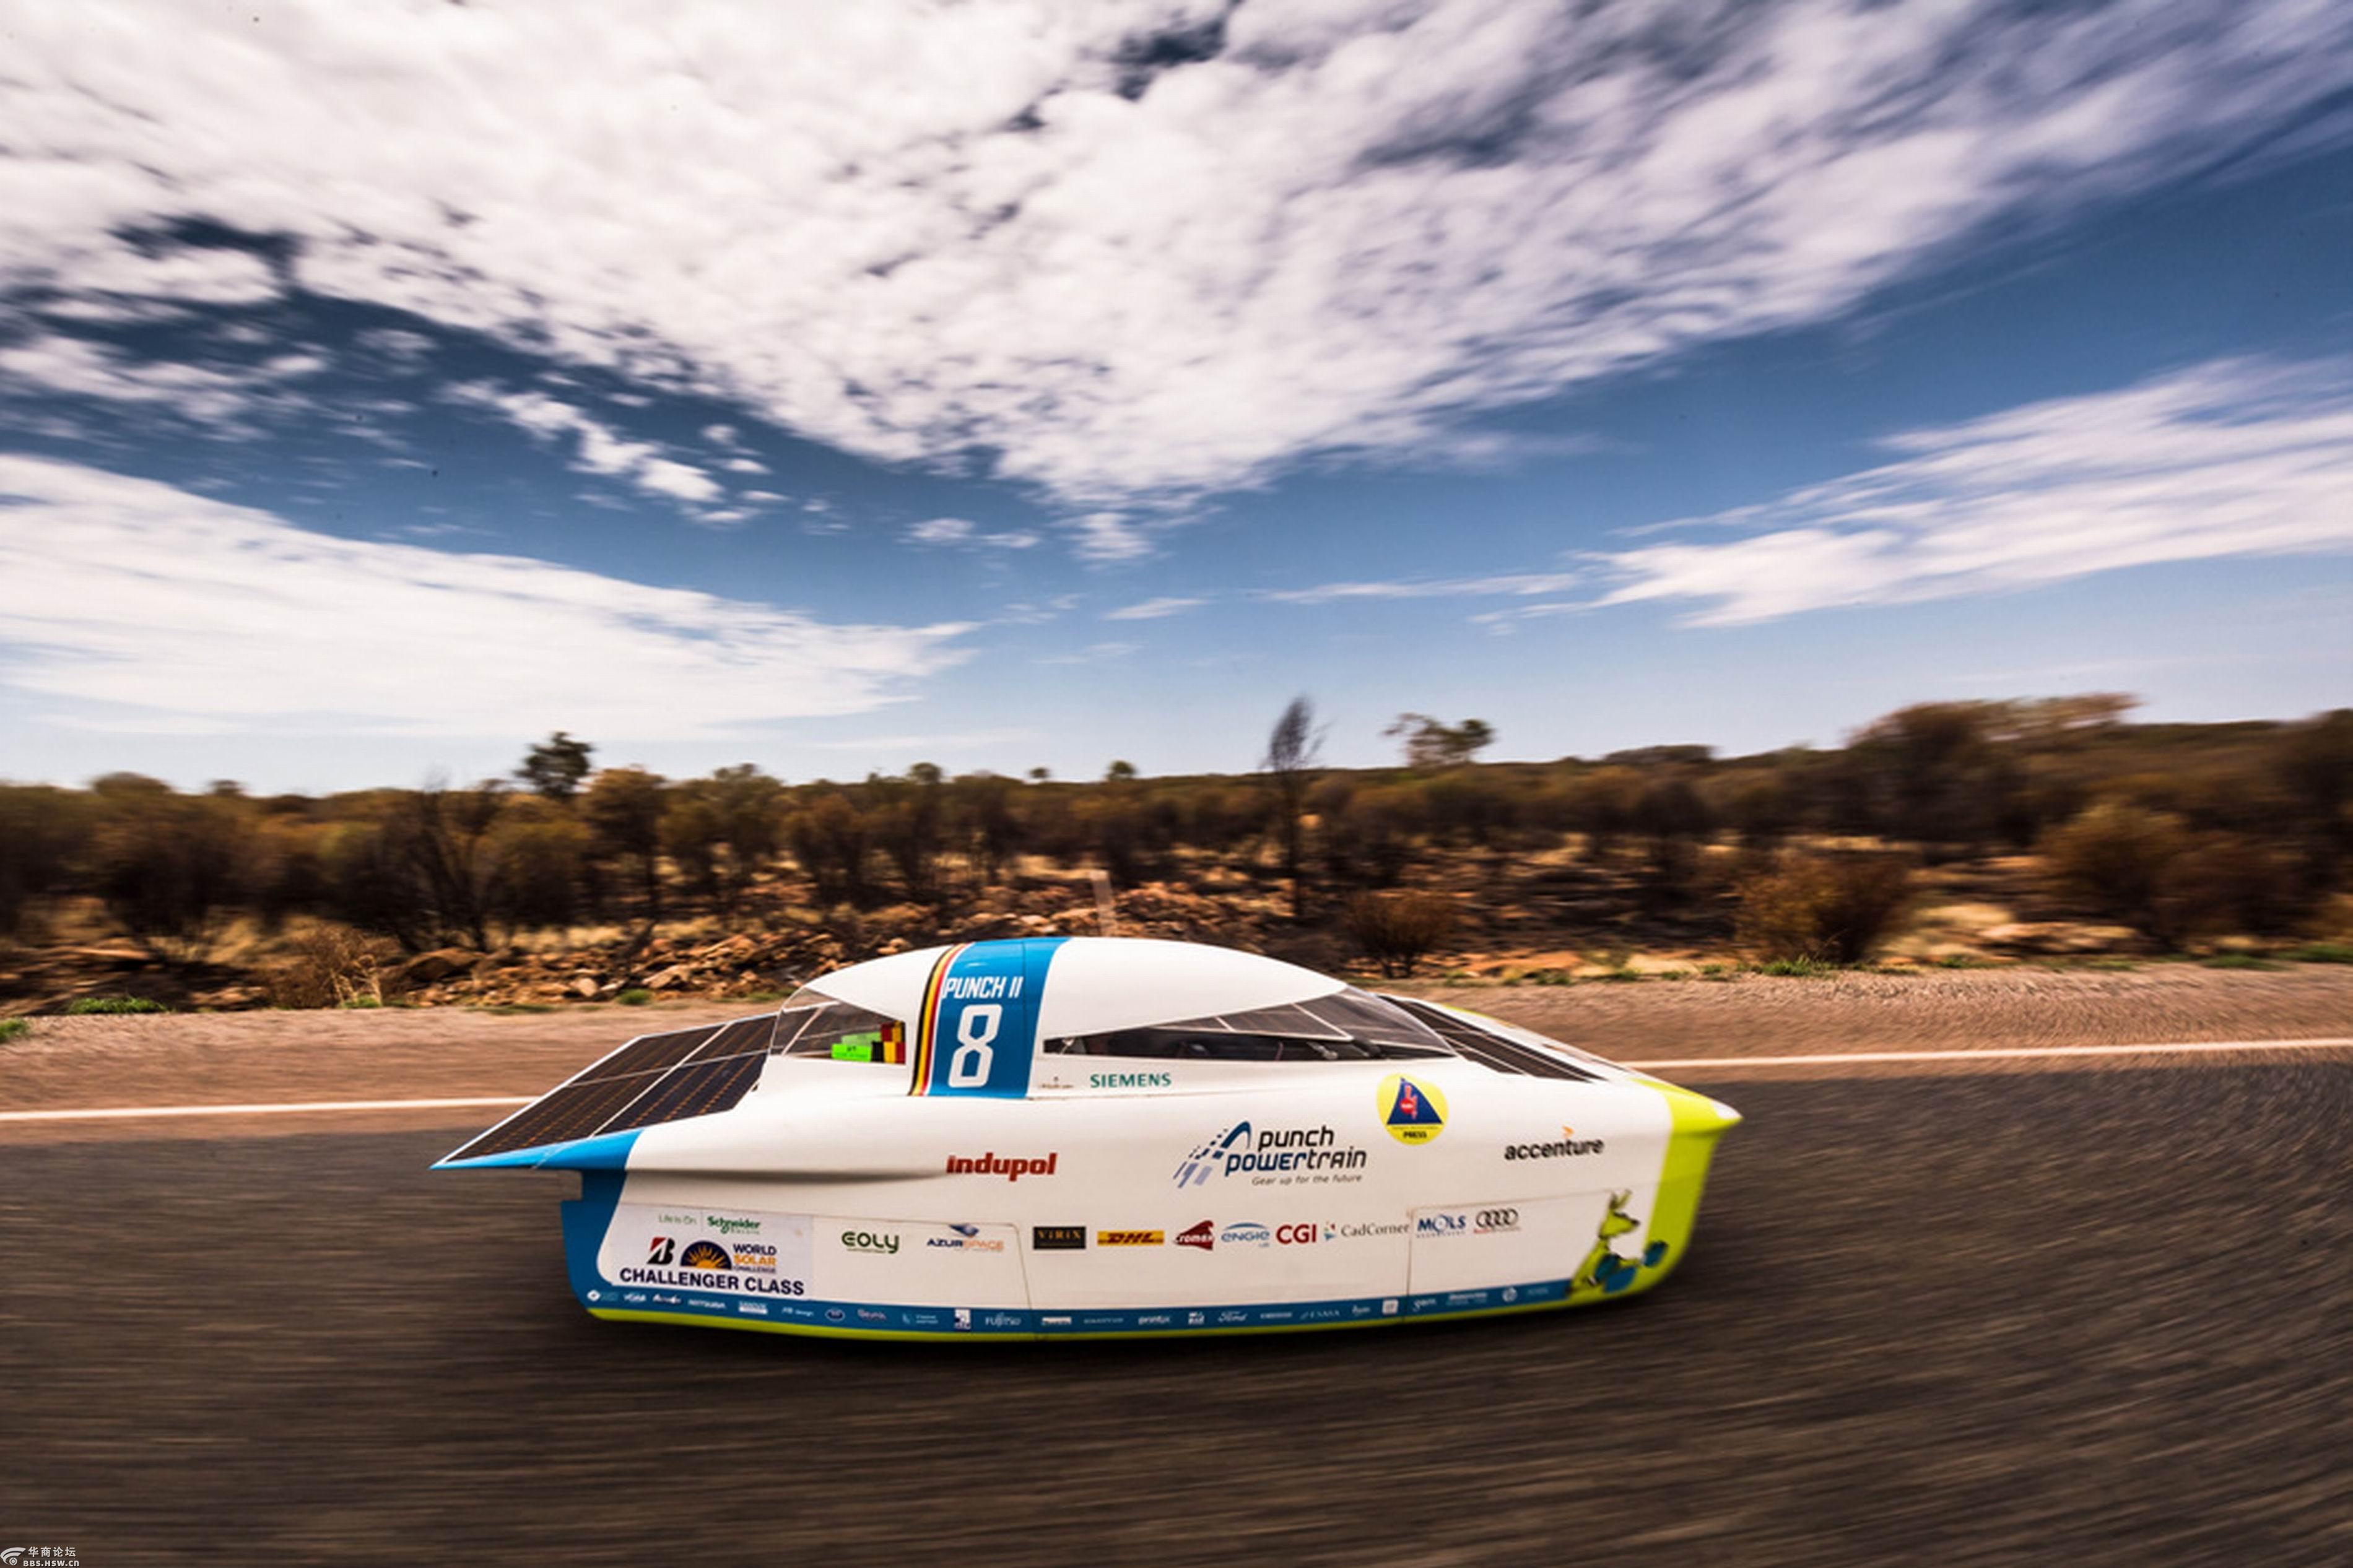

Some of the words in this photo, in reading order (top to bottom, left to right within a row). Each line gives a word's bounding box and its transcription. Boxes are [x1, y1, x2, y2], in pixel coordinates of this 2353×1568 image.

[941, 976, 1007, 998] PUNCH
[1008, 976, 1024, 998] II
[948, 1003, 1003, 1088] 8
[1090, 1073, 1172, 1088] SIEMENS
[1258, 1125, 1334, 1152] punch
[1504, 1140, 1604, 1161] accenture
[946, 1152, 1057, 1182] indupol
[1225, 1146, 1367, 1177] powertrain
[1251, 1177, 1276, 1185] Gear
[1279, 1177, 1292, 1185] up
[1312, 1175, 1329, 1183] the
[1333, 1174, 1362, 1182] future
[707, 1216, 760, 1234] Schneider
[1276, 1224, 1317, 1244] CGI
[1341, 1222, 1410, 1237] CadCorner
[842, 1231, 900, 1254] EOLY
[1107, 1232, 1155, 1243] DHL
[733, 1243, 776, 1256] WORLD
[734, 1255, 776, 1266] SOLAR
[620, 1267, 739, 1290] CHALLENGER
[745, 1277, 804, 1296] CLASS
[1218, 1311, 1248, 1323] Ford
